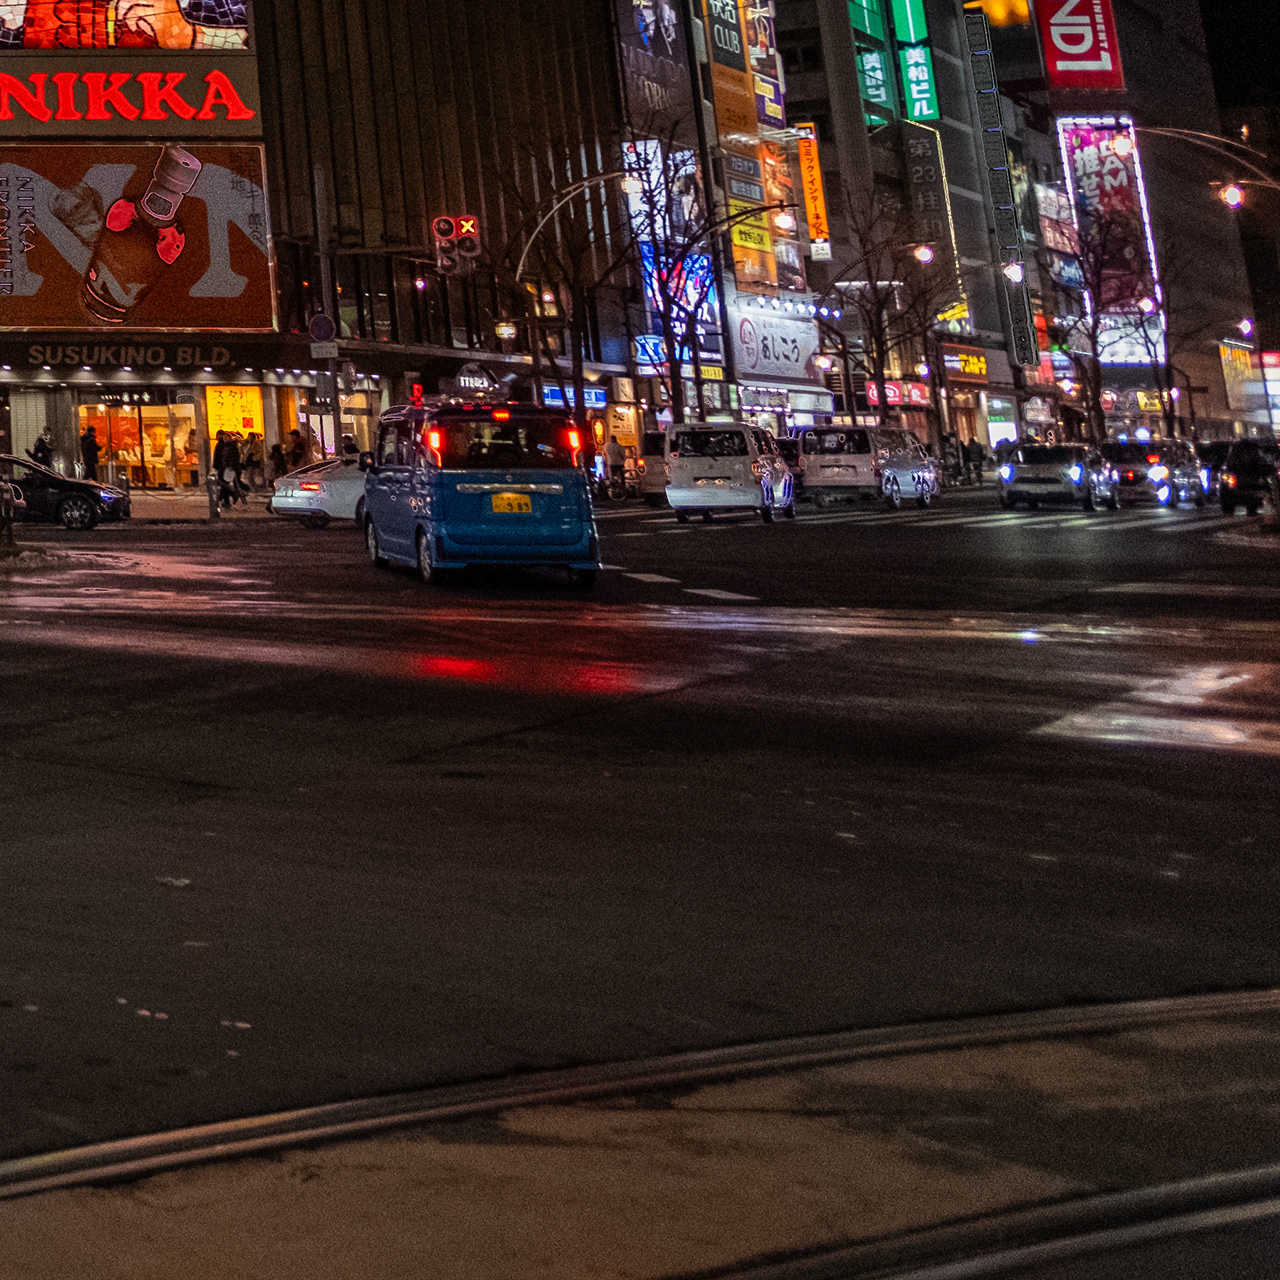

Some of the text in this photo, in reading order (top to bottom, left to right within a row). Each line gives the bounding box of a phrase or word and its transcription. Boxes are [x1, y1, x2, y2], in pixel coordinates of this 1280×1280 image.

[714, 24, 740, 54] CLUB
[16, 176, 36, 253] NIKKA
[28, 346, 236, 365] SUSUKINO BLD.
